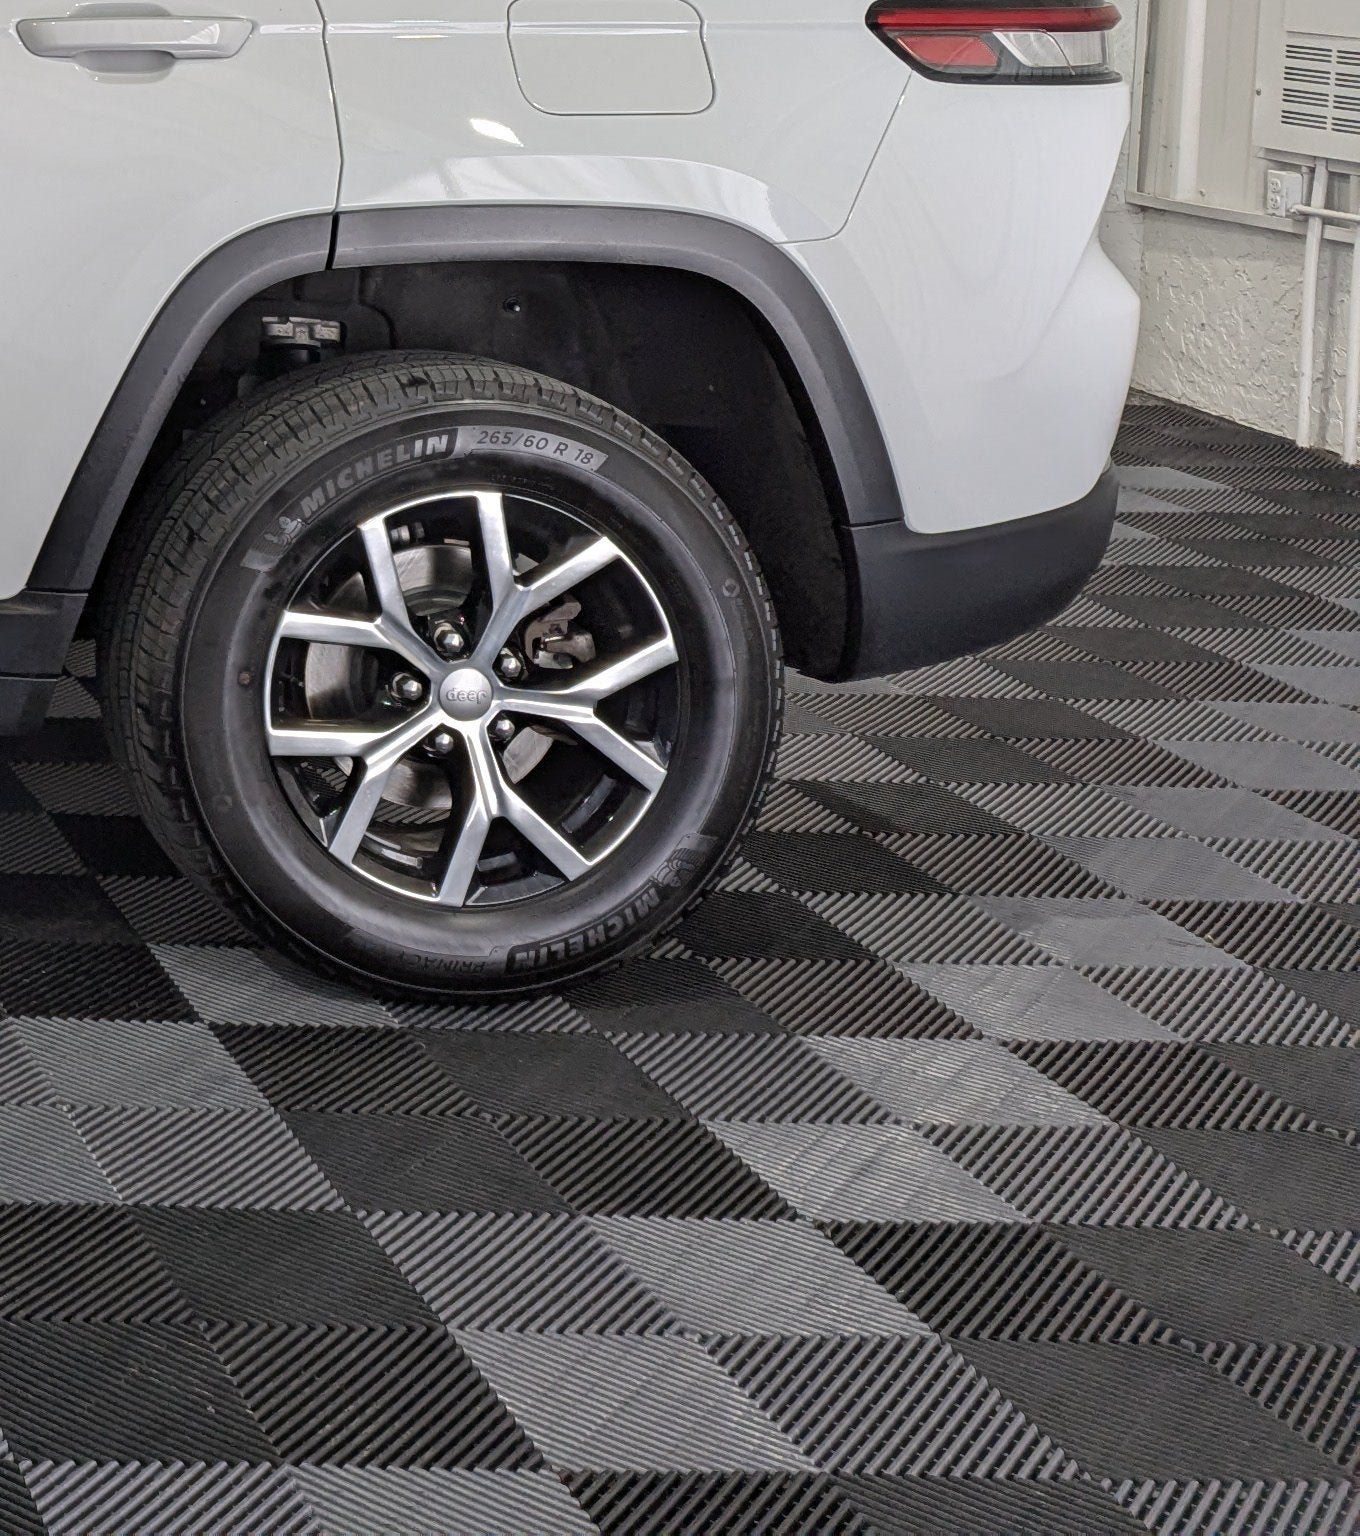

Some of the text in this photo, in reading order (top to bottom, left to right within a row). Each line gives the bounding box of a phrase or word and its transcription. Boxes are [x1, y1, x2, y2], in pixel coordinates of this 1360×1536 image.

[298, 430, 595, 518] MICHELIN 265/60 R 18
[445, 687, 487, 705] Jeep
[514, 886, 661, 972] MICHELIN
